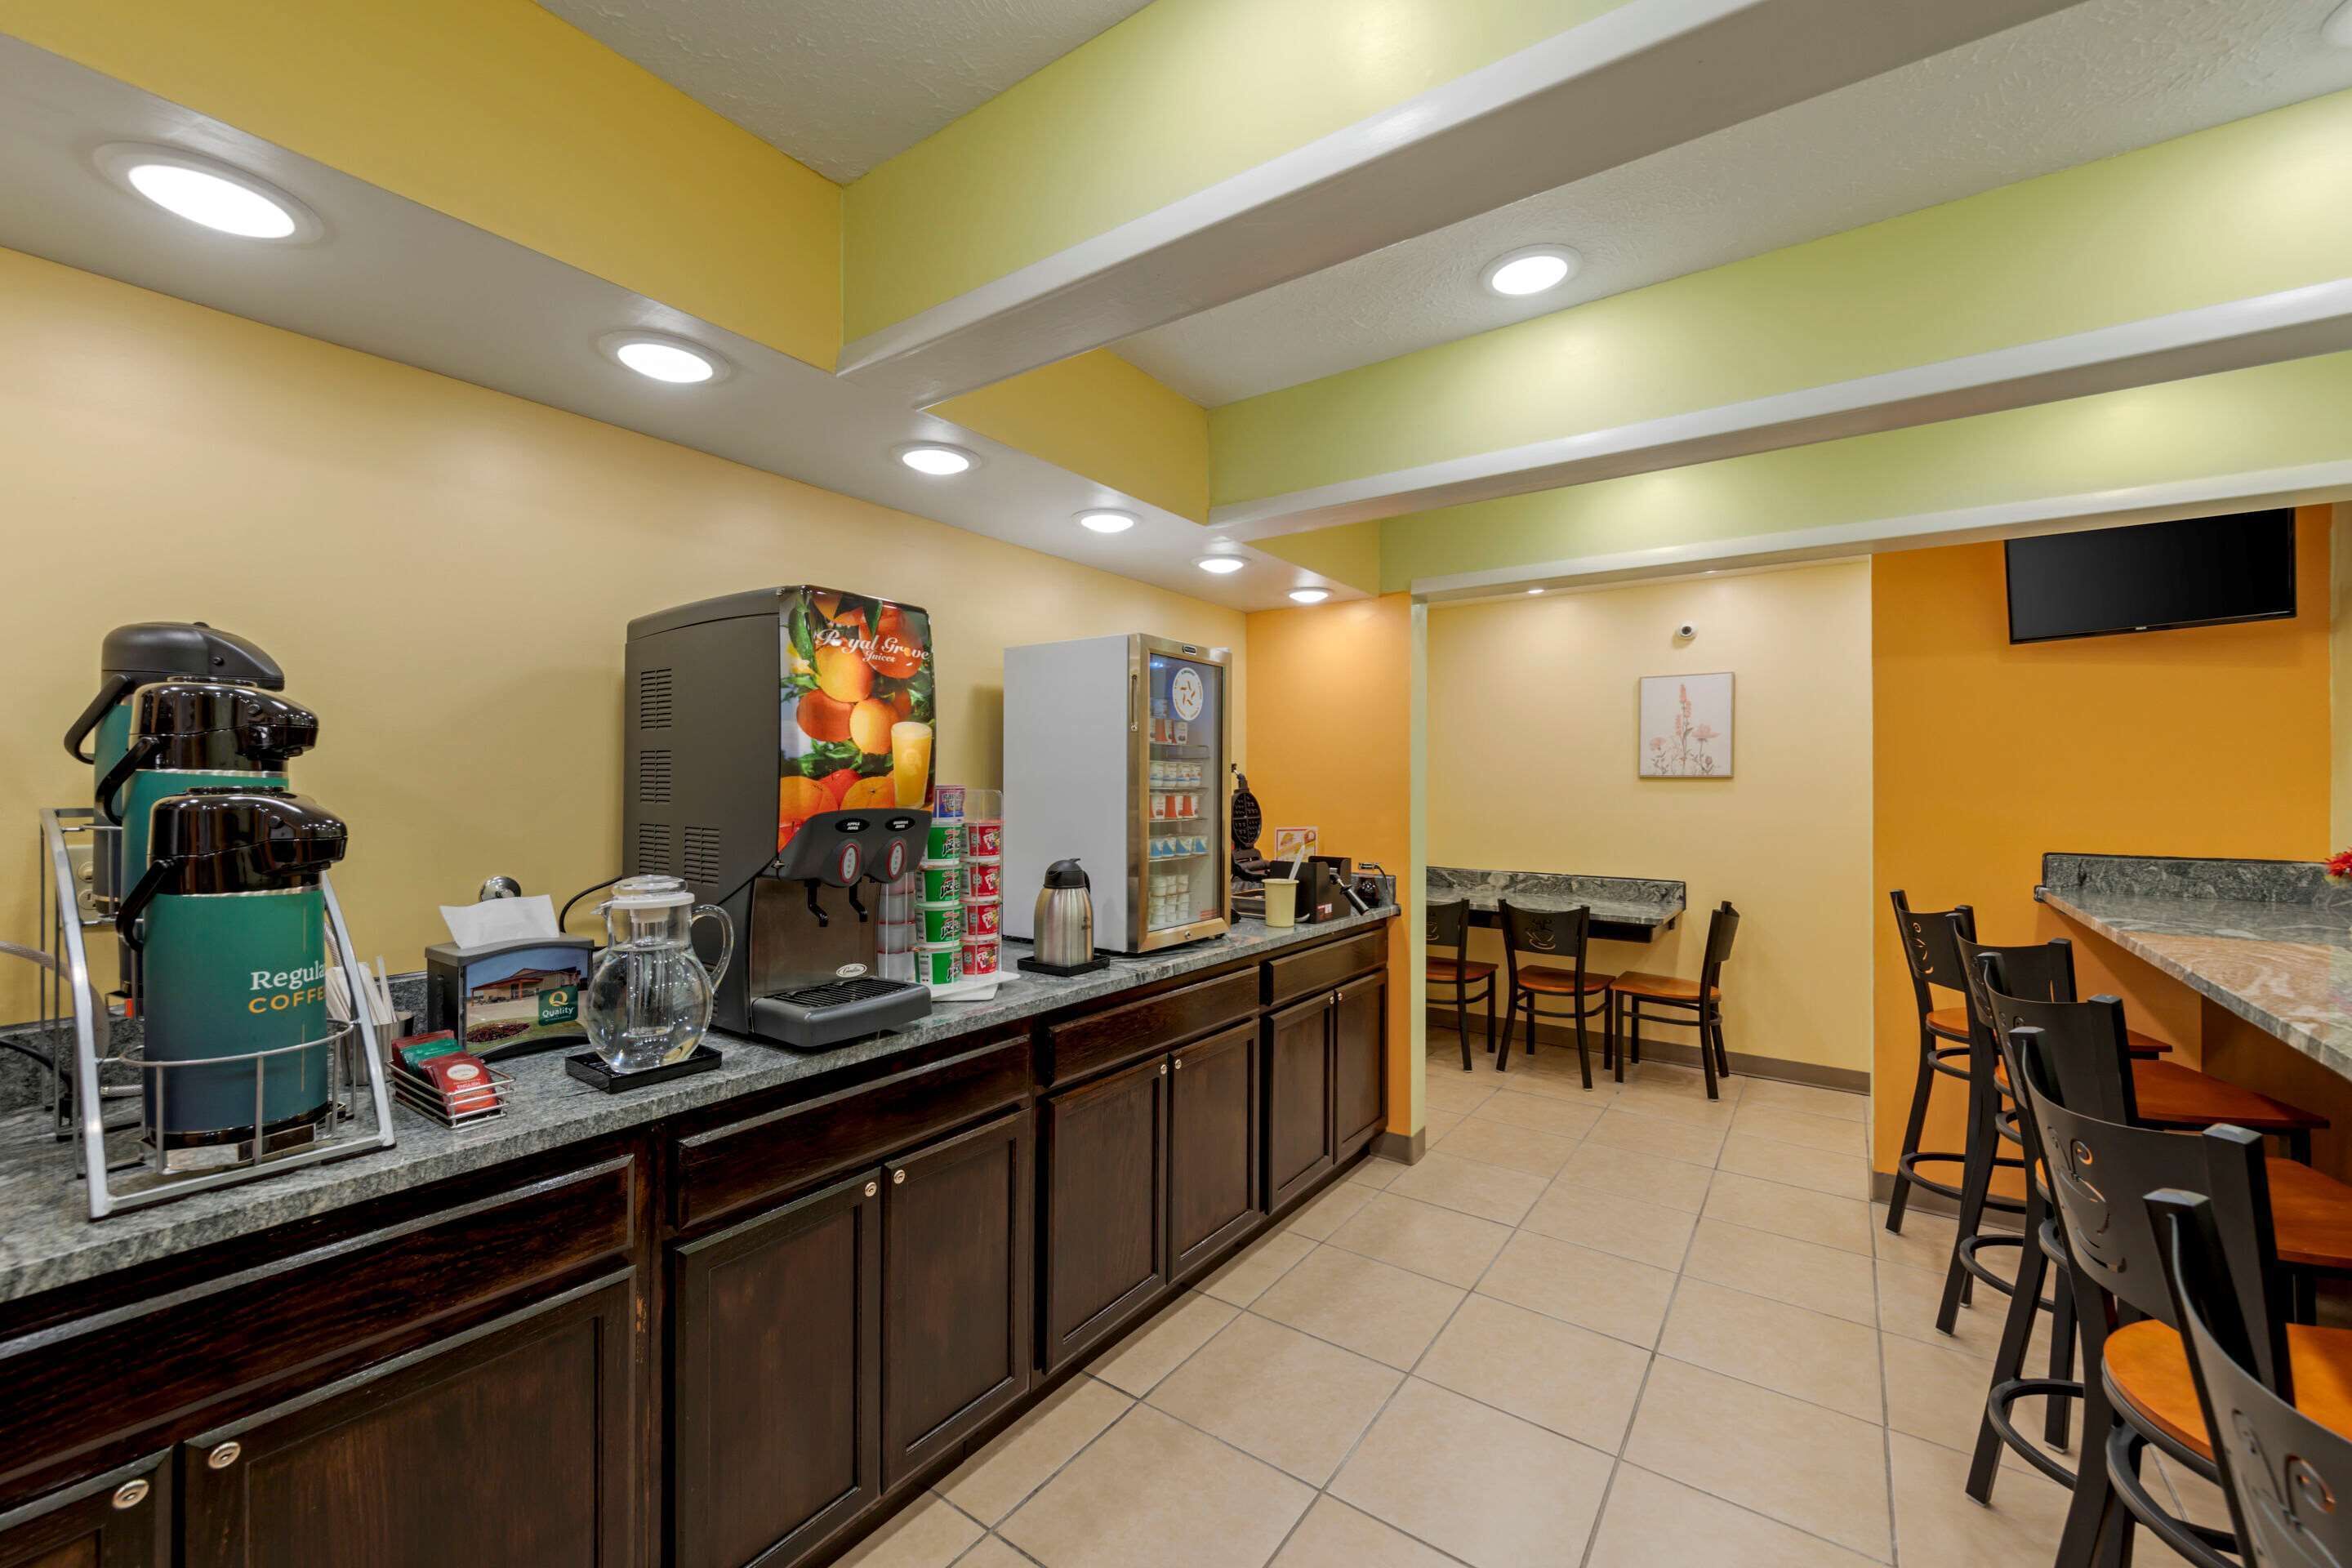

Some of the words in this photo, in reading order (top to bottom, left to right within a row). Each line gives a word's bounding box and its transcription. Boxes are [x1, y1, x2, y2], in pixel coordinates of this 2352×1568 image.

[815, 629, 880, 653] Royal
[881, 636, 930, 660] Grove
[249, 960, 325, 990] Regula
[248, 987, 326, 1013] COFFE
[542, 1007, 573, 1018] Quality
